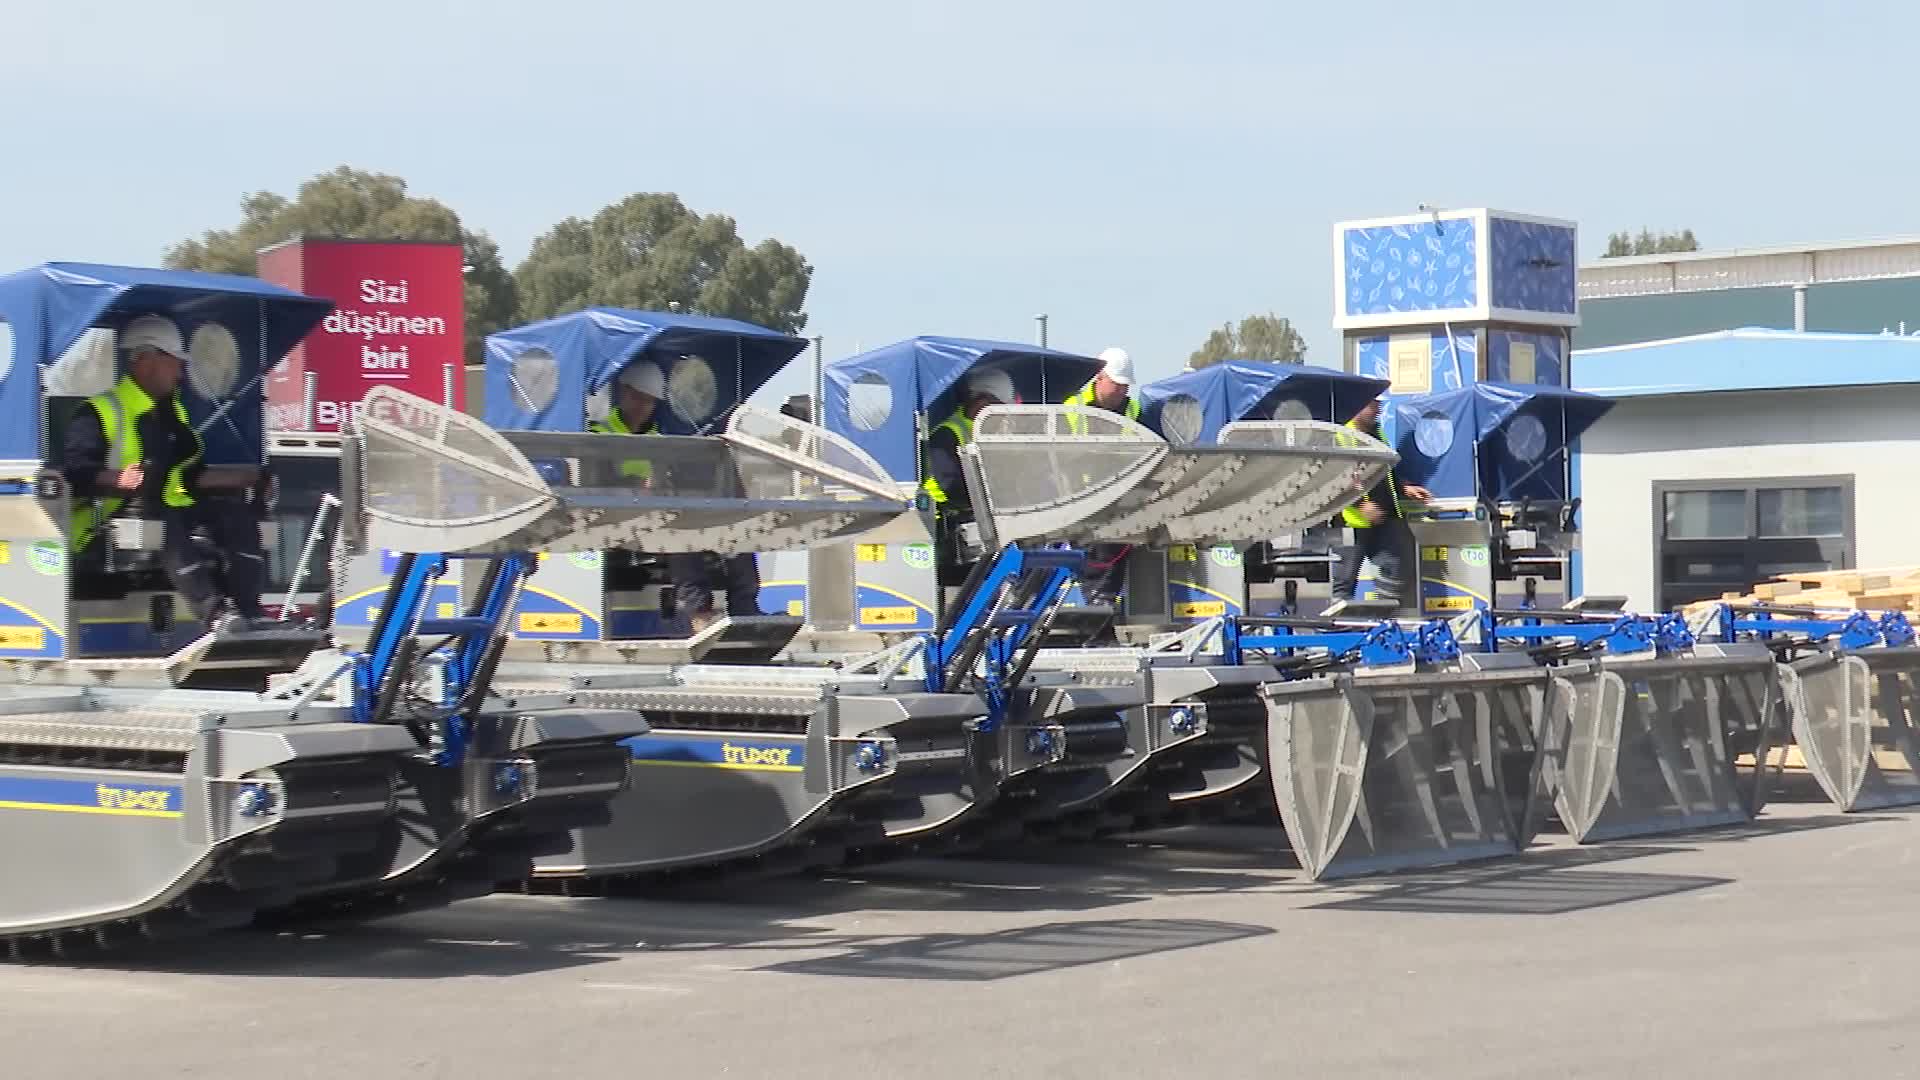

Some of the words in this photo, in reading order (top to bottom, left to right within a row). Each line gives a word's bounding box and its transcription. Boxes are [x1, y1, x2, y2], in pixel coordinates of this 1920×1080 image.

[360, 279, 409, 303] Sizi
[323, 310, 446, 340] düşünen
[360, 345, 409, 369] biri
[907, 549, 929, 562] T30
[1217, 549, 1236, 562] T30
[721, 742, 792, 766] truxor
[95, 783, 171, 811] truxor
